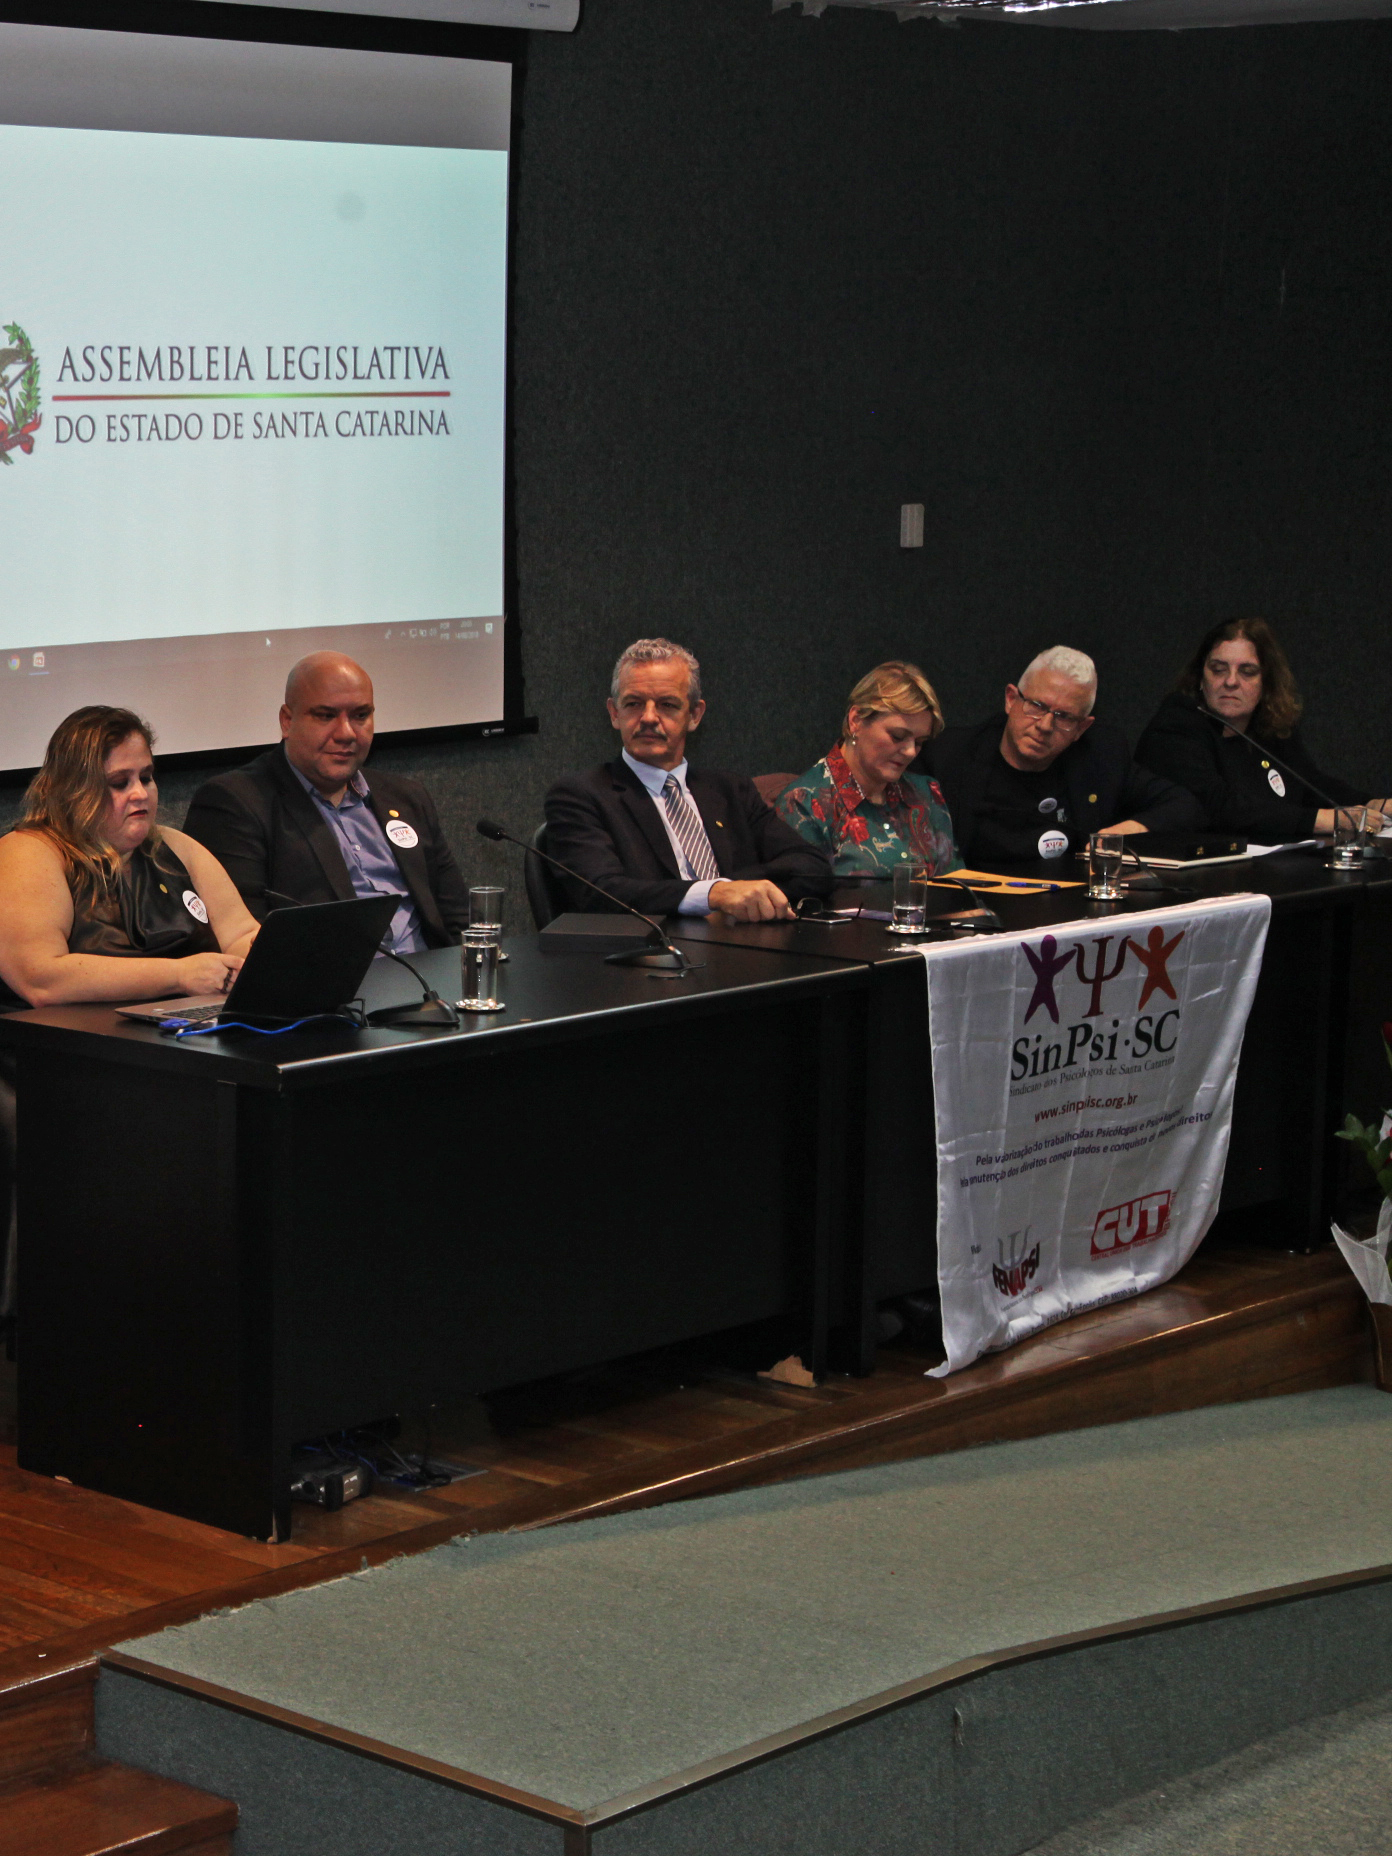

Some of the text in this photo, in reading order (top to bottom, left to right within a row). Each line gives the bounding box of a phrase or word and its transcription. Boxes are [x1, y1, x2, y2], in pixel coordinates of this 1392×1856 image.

[56, 345, 450, 382] ASSEMBLEIA LEGISLATIVA
[54, 414, 96, 444] DO
[105, 412, 203, 443] ESTADO
[212, 412, 244, 440] DE
[252, 411, 329, 439] SANTA
[335, 410, 450, 438] CATARINA
[1105, 1064, 1117, 1075] de
[1034, 1093, 1138, 1123] www.sinpisc.org.br
[975, 1155, 993, 1166] Pela
[994, 1147, 1033, 1164] vaorização
[1044, 1131, 1079, 1149] trabalho
[1079, 1129, 1094, 1138] das
[1092, 1191, 1169, 1253] CUT
